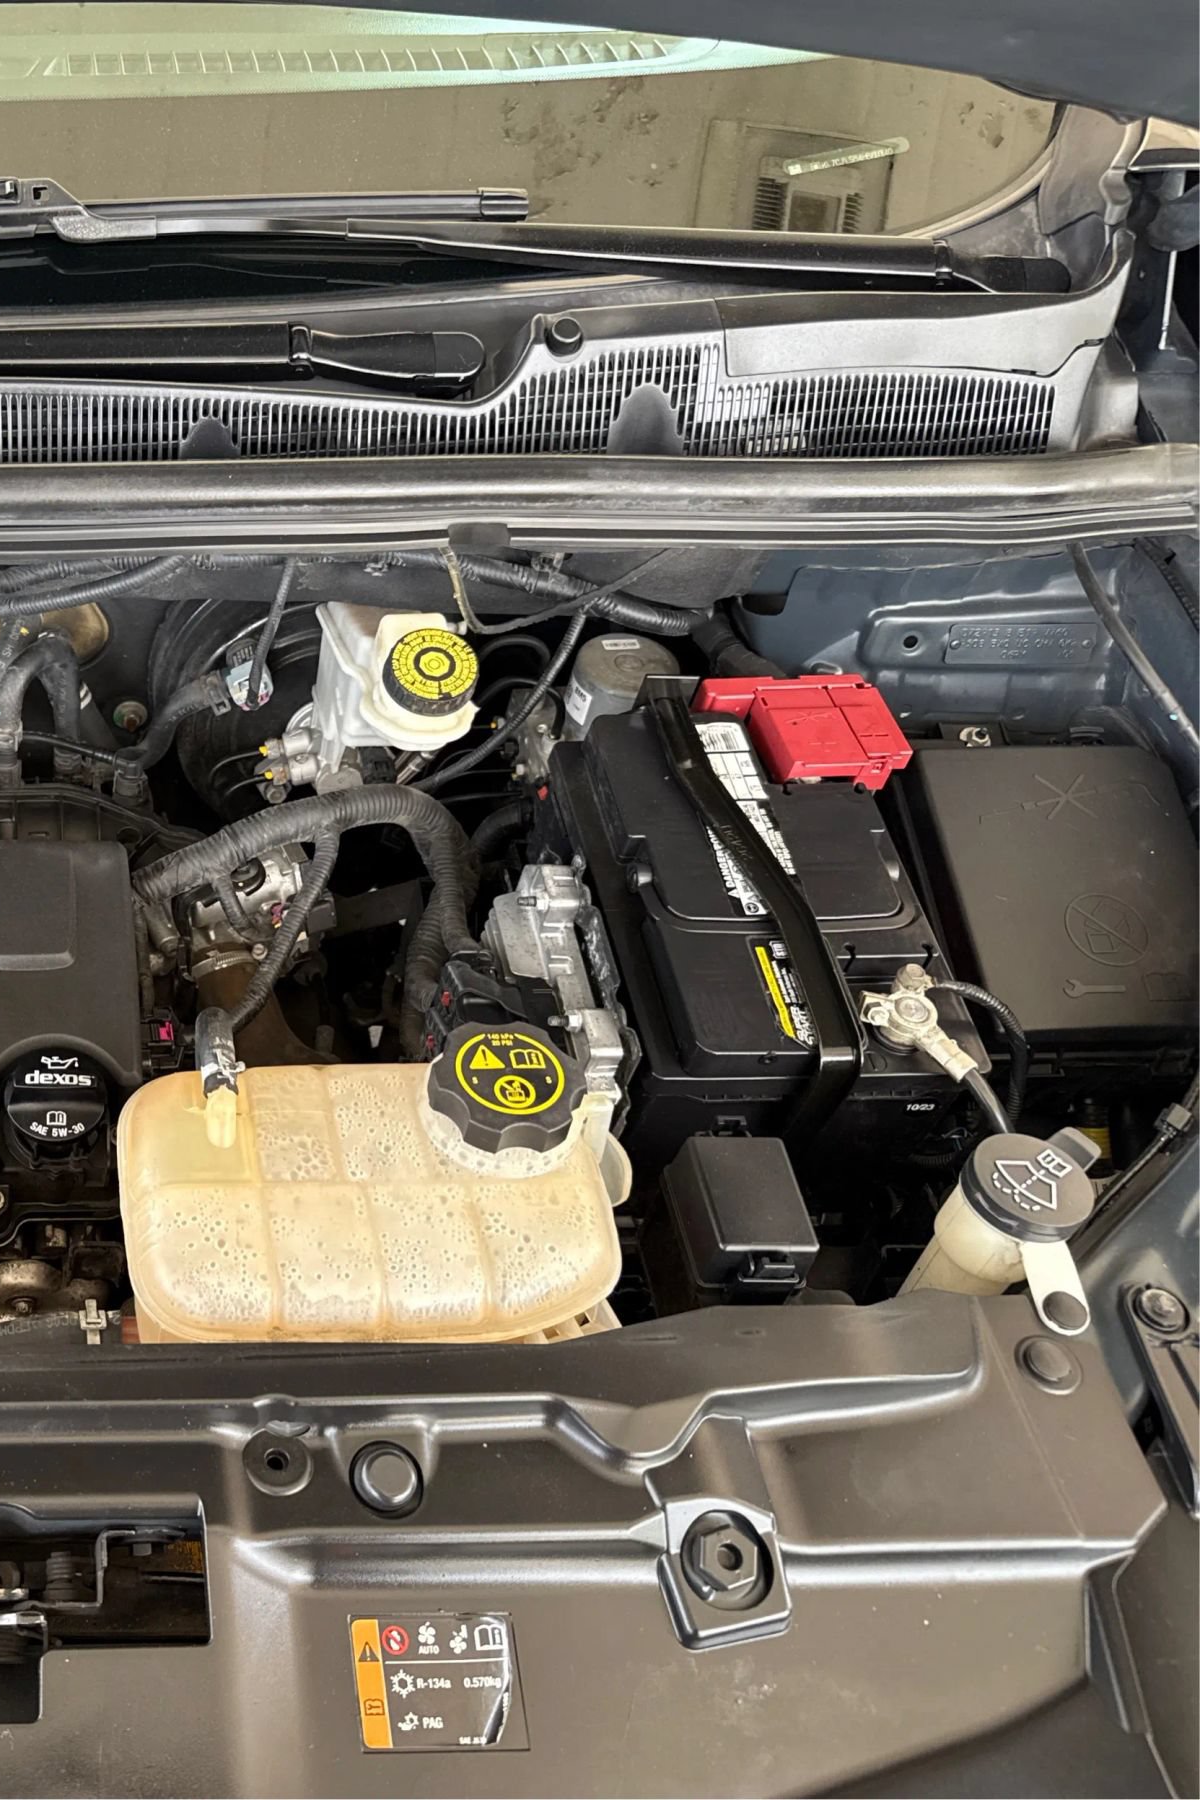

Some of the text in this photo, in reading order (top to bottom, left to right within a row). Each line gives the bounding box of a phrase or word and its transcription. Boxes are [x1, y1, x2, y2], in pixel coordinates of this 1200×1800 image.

[24, 1069, 92, 1086] dexos
[29, 1121, 85, 1137] SAE 5W-30
[418, 1645, 440, 1655] AUTO
[416, 1677, 452, 1689] R-134a
[422, 1717, 444, 1729] PAG
